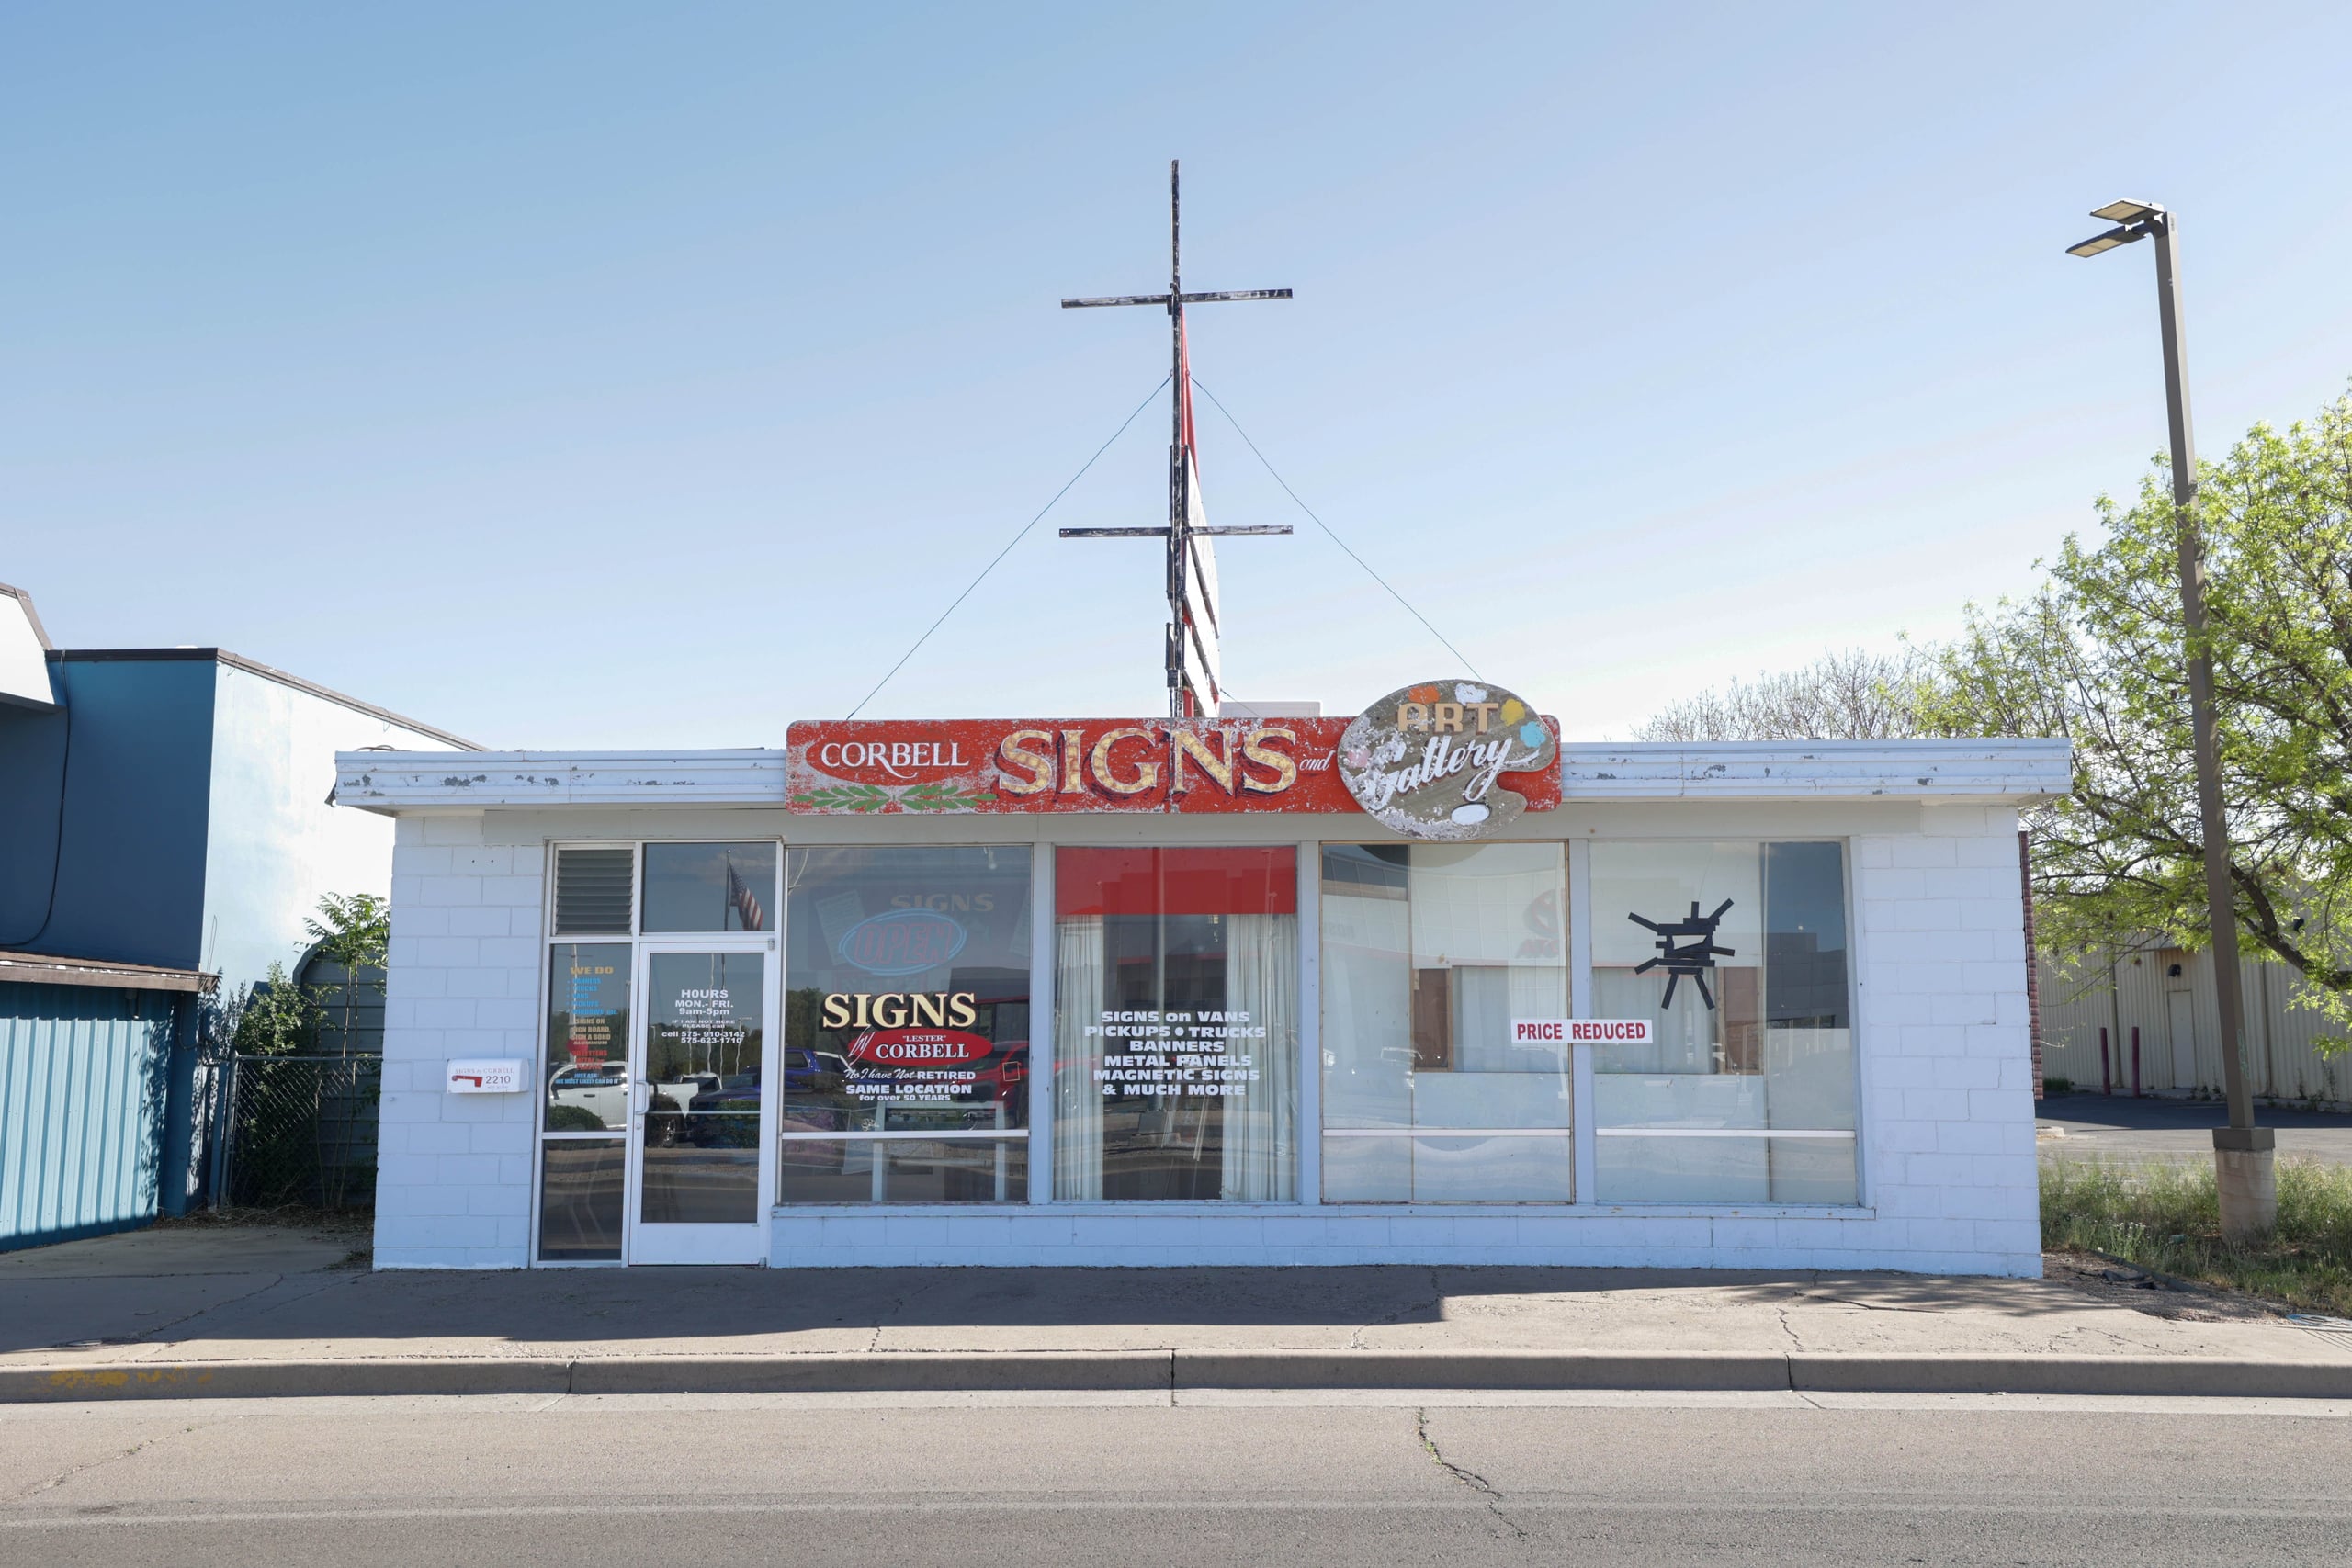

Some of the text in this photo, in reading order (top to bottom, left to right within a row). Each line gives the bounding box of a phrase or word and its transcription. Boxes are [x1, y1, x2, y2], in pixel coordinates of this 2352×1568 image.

[1397, 702, 1498, 733] ART
[820, 726, 1336, 799] CORBELL SIGNS and
[1365, 736, 1540, 810] Gallery
[854, 923, 953, 964] OPEN
[681, 989, 729, 998] HOURS
[679, 1008, 729, 1016] 9am-5pm
[820, 992, 977, 1029] SIGNS
[1102, 1011, 1250, 1022] SIGNS on VANS
[1084, 1026, 1266, 1038] PICKUPS TRUCKS
[1517, 1022, 1646, 1040] PRICE REDUCED
[848, 1024, 875, 1066] by
[876, 1043, 969, 1059] CORBELL
[1130, 1041, 1225, 1052] BANNERS
[1104, 1055, 1252, 1066] METAL PANELS
[486, 1076, 511, 1084] 2210
[843, 1068, 860, 1080] No
[869, 1068, 892, 1080] have
[892, 1068, 916, 1080] Not
[918, 1071, 976, 1080] RETIRED
[1093, 1070, 1260, 1081] MAGNETIC SIGNS
[846, 1084, 972, 1094] SAME LOCATION
[1102, 1085, 1246, 1095] & MUCH MORE
